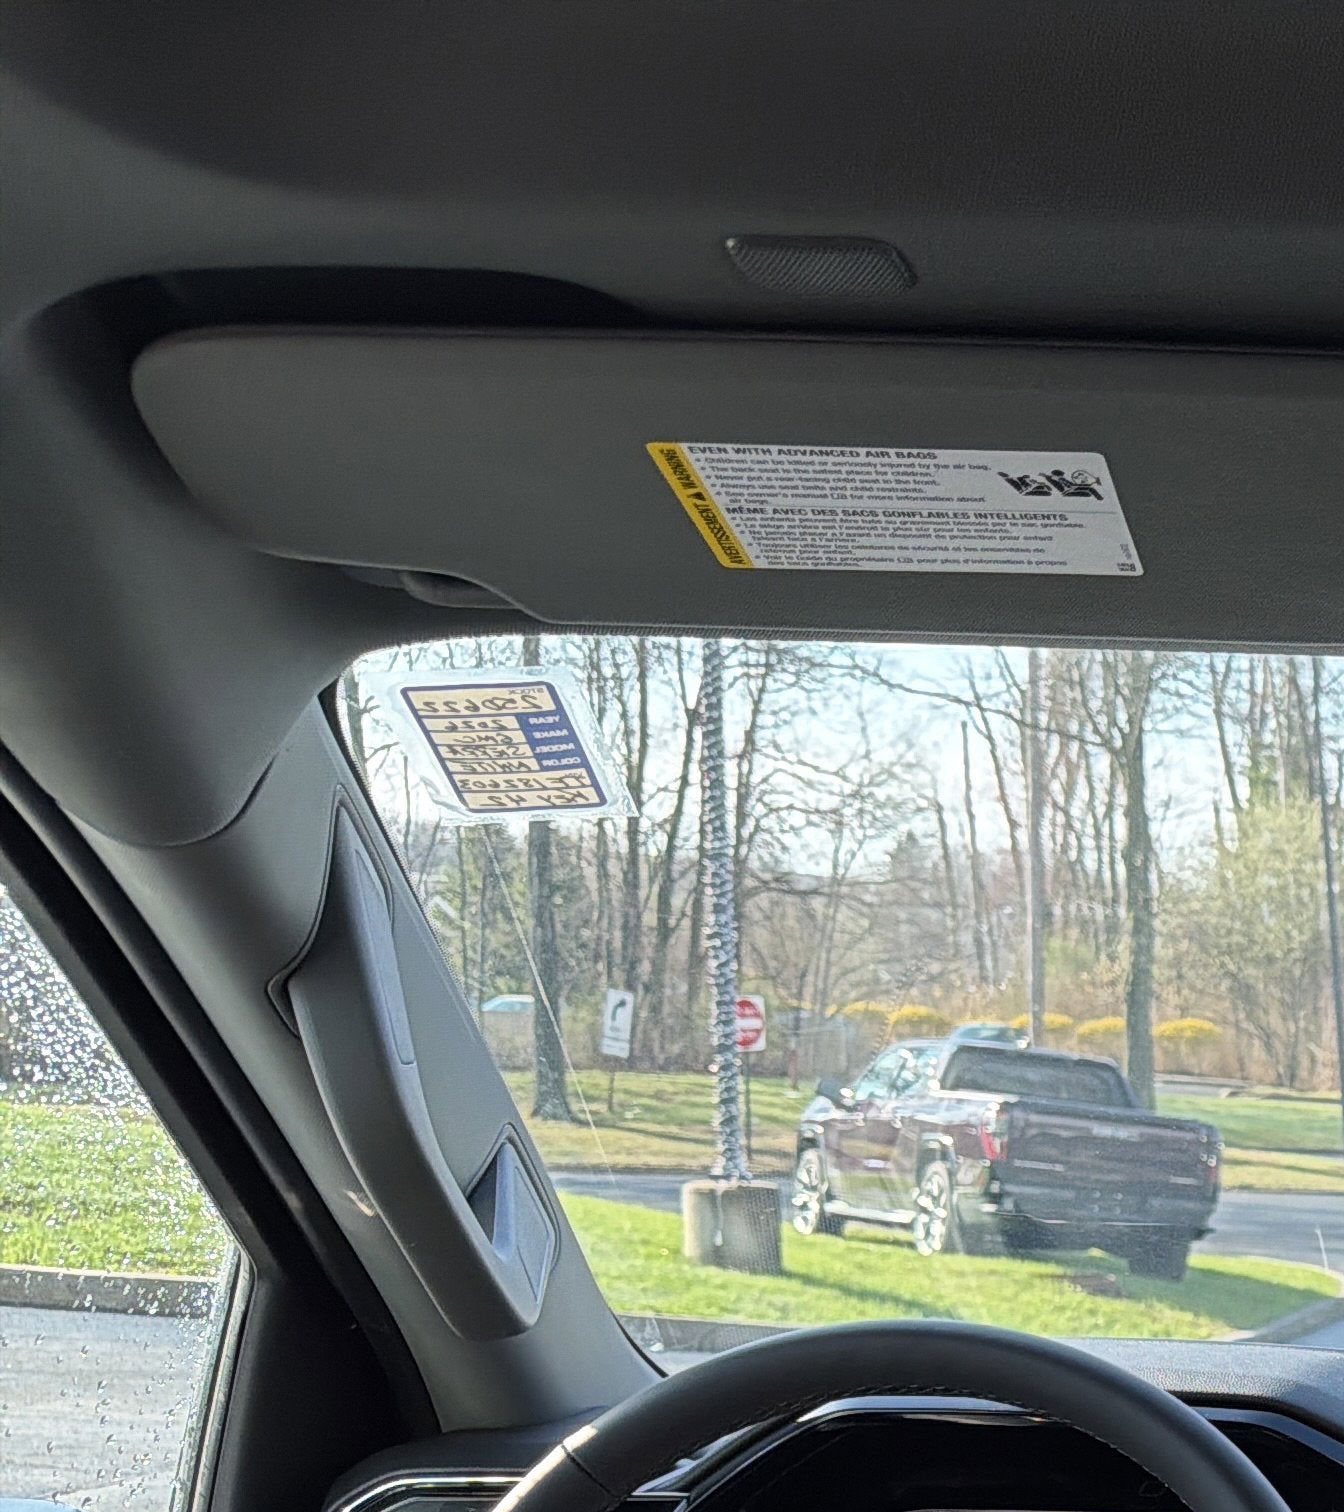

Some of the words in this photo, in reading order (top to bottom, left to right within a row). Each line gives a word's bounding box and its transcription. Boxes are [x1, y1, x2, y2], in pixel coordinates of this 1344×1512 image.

[687, 446, 728, 455] EVEN
[732, 446, 772, 456] WITH
[778, 448, 860, 459] ADVANCED
[865, 450, 891, 459] AIR
[896, 450, 938, 460] BAGS
[658, 448, 697, 489] WARNING
[725, 505, 767, 516] MÊME
[772, 507, 808, 517] AVEC
[811, 508, 839, 517] DES
[842, 509, 879, 518] SACS
[882, 510, 970, 520] GONFLABLES
[974, 512, 1068, 521] INTELLIGENTS
